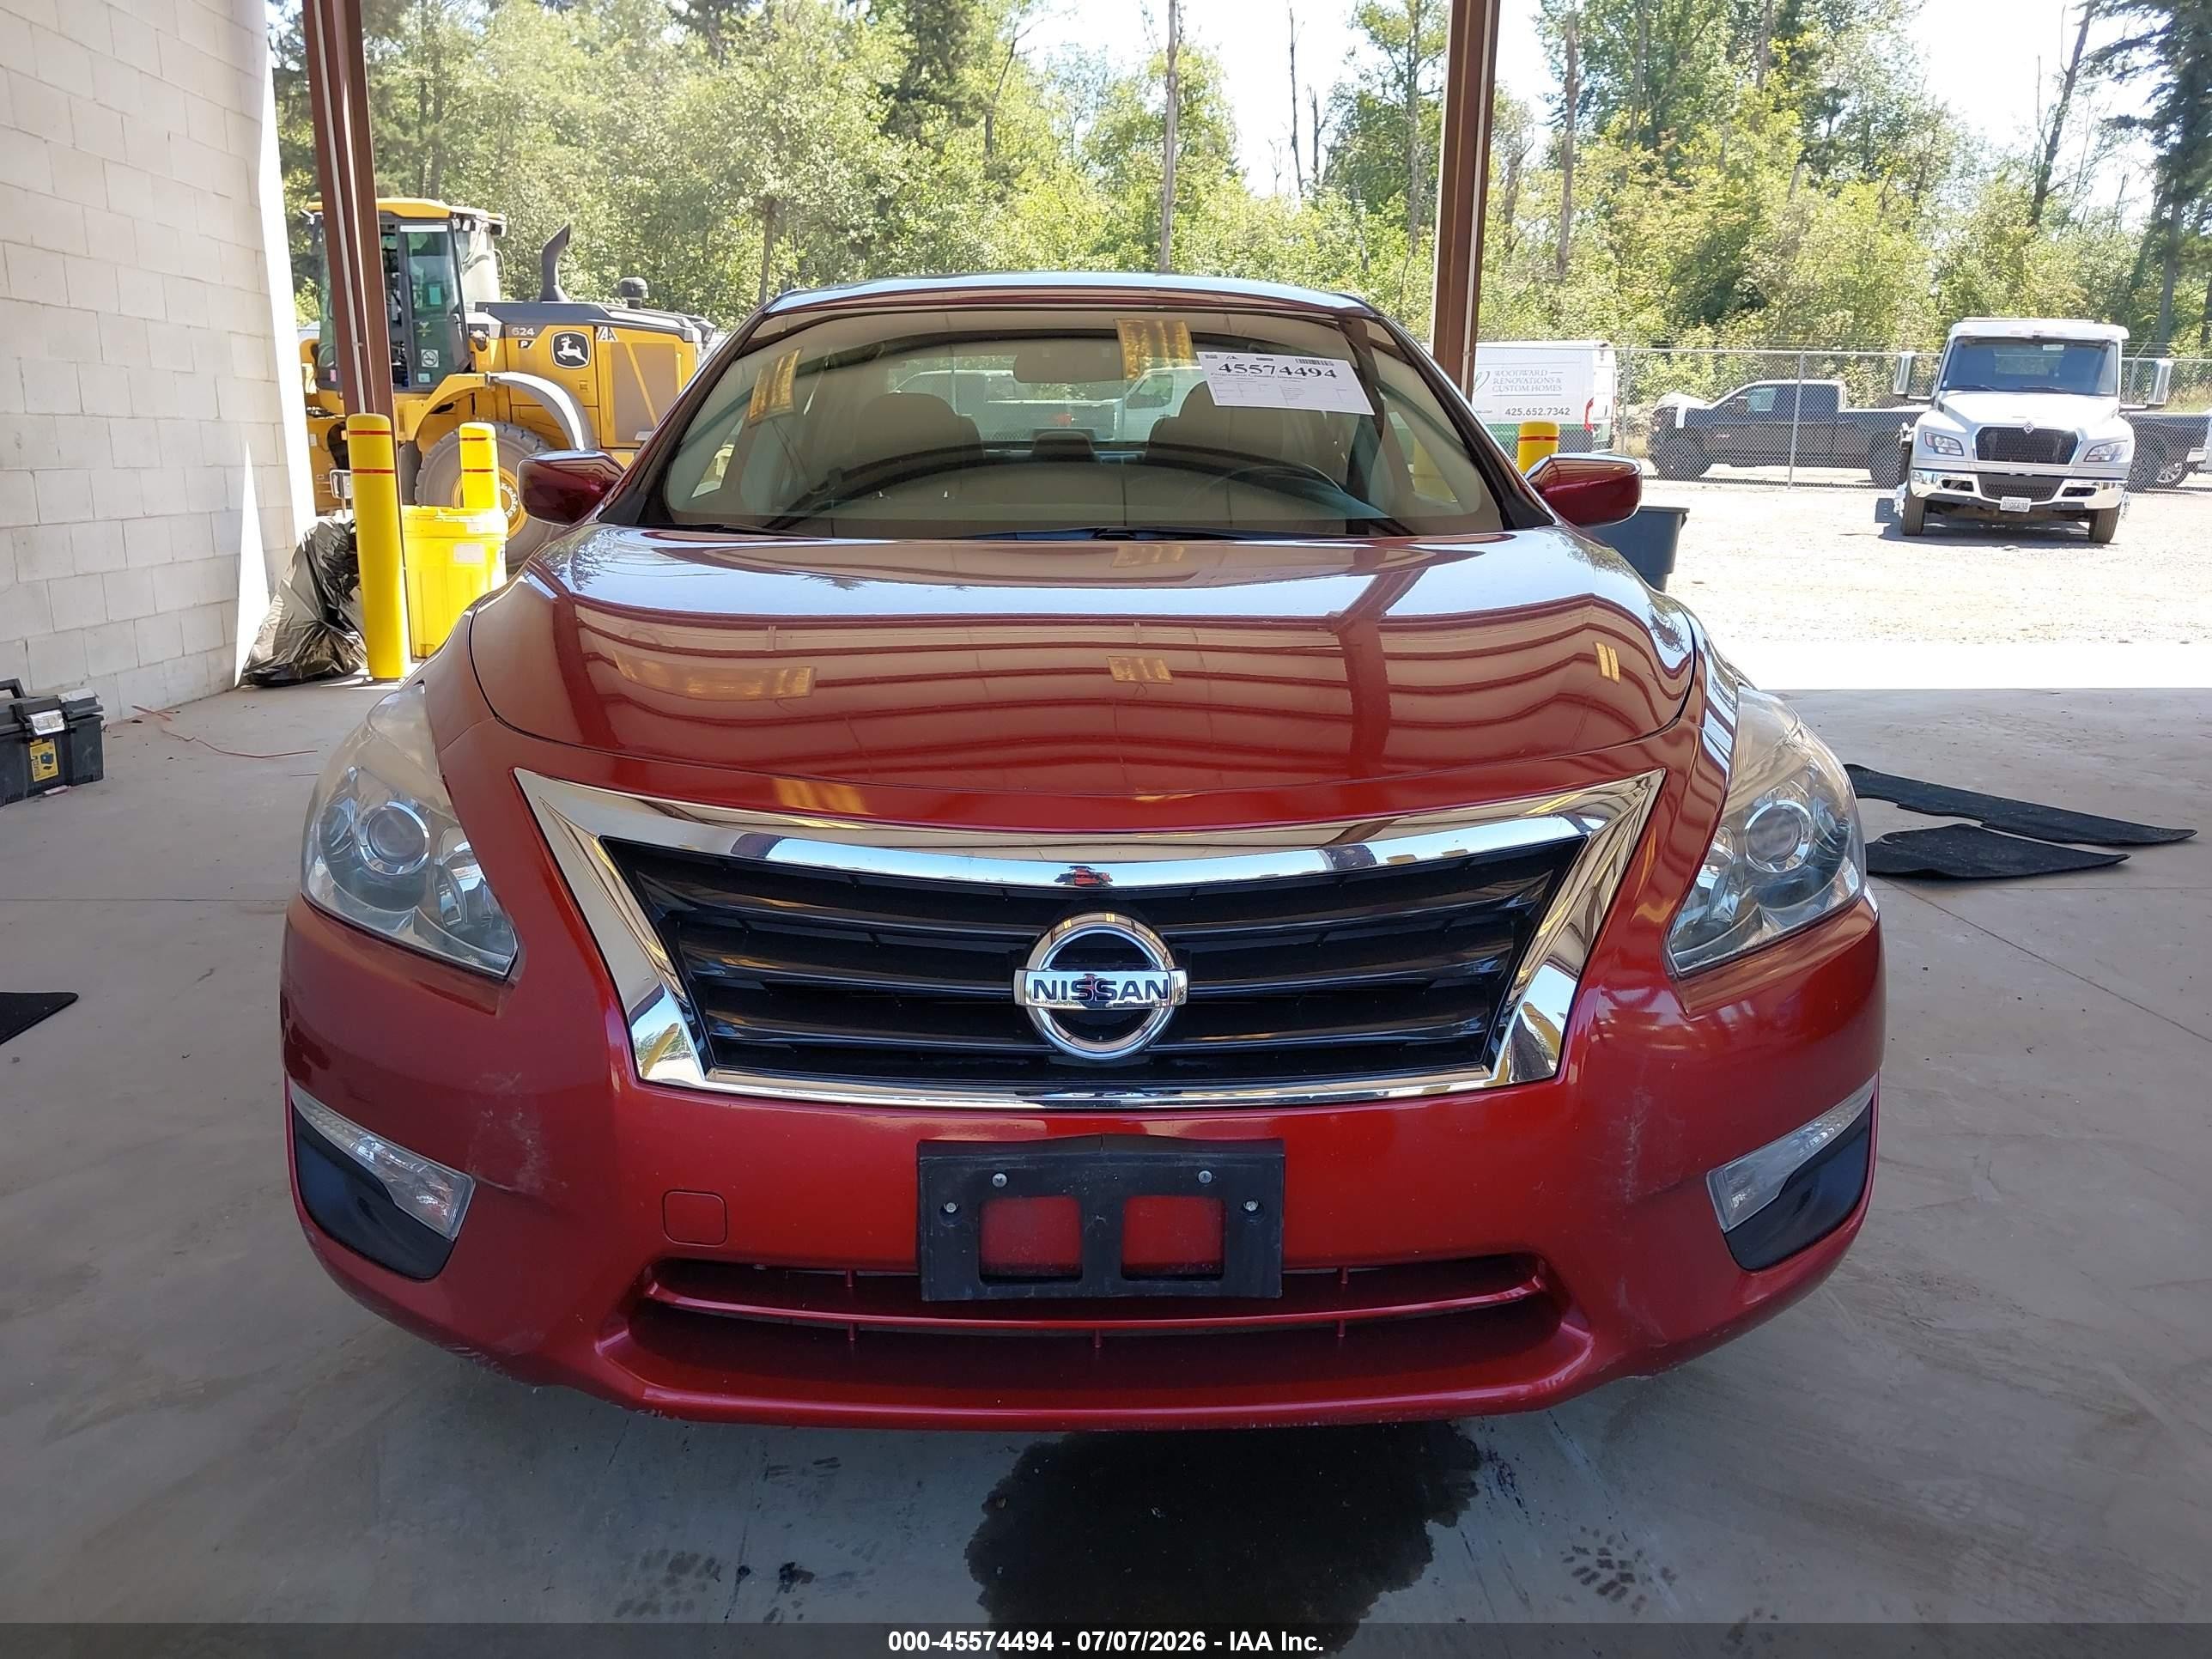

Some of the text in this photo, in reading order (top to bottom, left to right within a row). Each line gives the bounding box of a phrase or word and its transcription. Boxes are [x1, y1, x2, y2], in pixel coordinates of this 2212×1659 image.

[512, 327, 535, 336] 624
[1218, 363, 1338, 380] 45574494
[1504, 407, 1571, 416] 425.652.7342
[1033, 979, 1169, 1001] NISSAN
